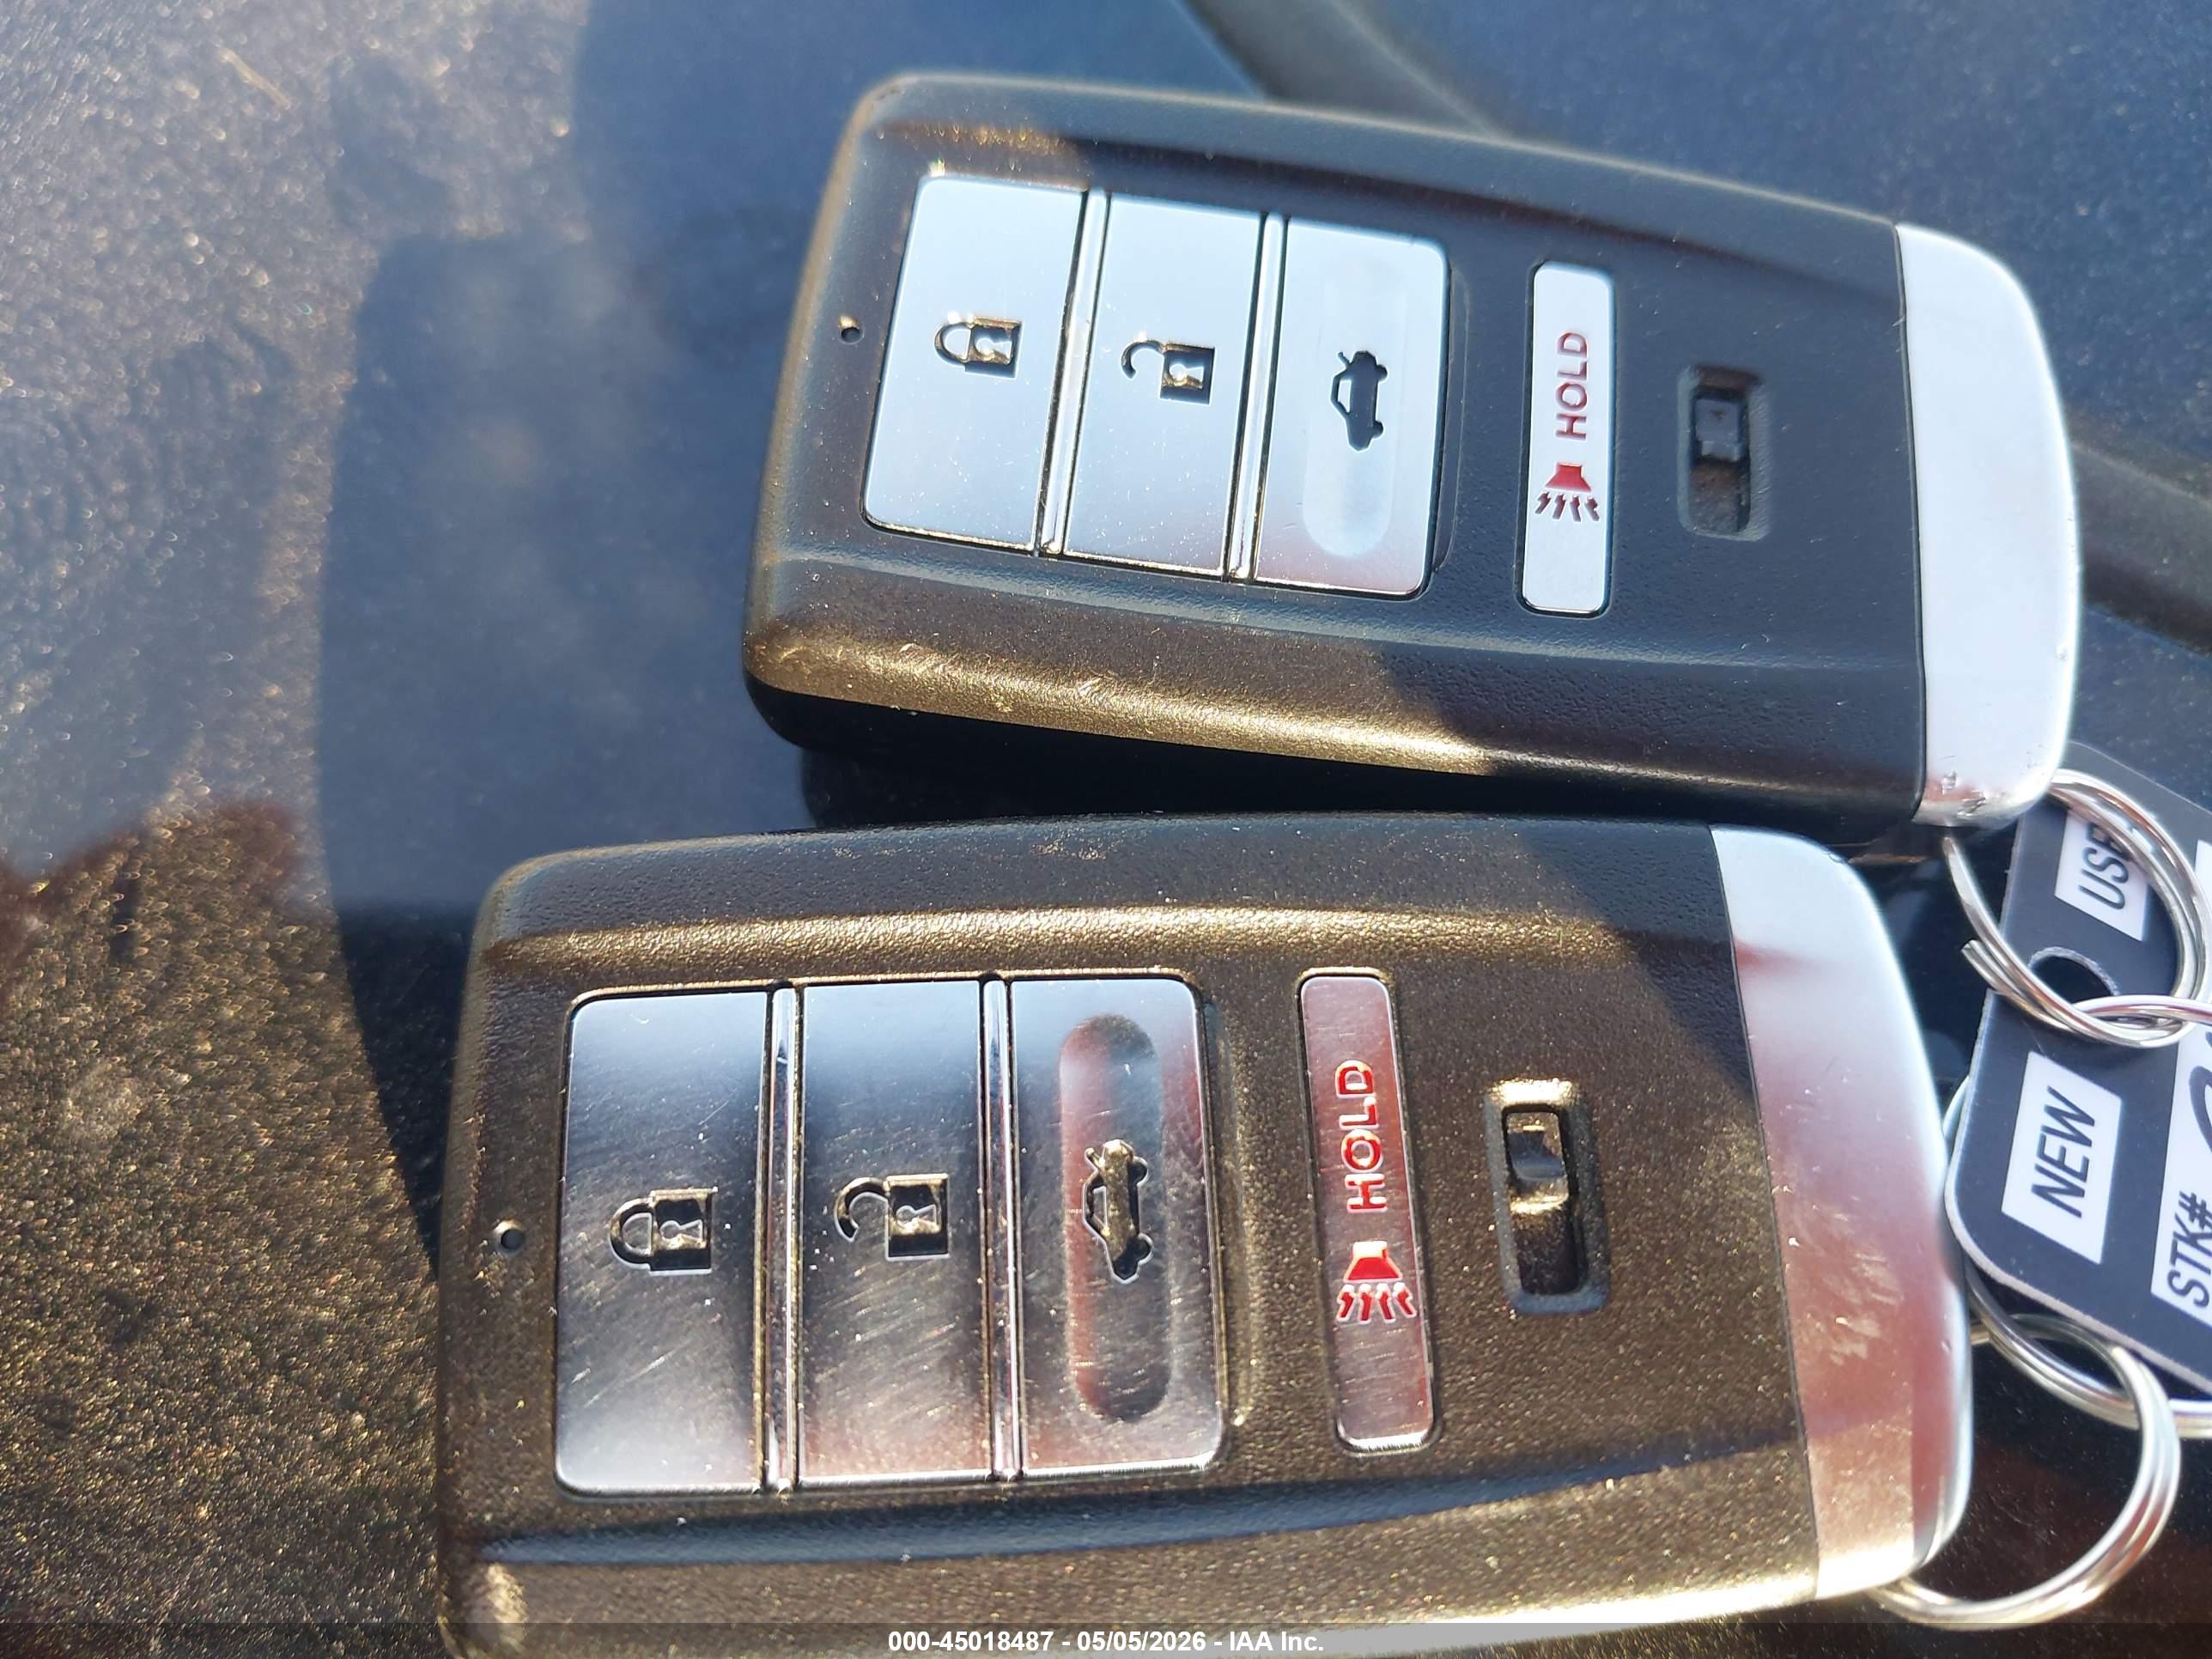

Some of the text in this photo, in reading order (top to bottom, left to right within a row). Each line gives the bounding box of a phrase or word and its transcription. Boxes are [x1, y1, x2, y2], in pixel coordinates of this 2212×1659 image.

[1555, 331, 1588, 441] HOLD
[2079, 822, 2131, 910] USE
[1334, 1060, 1388, 1212] HOLD
[2030, 1085, 2095, 1218] NEW
[2166, 1190, 2212, 1308] STK#
